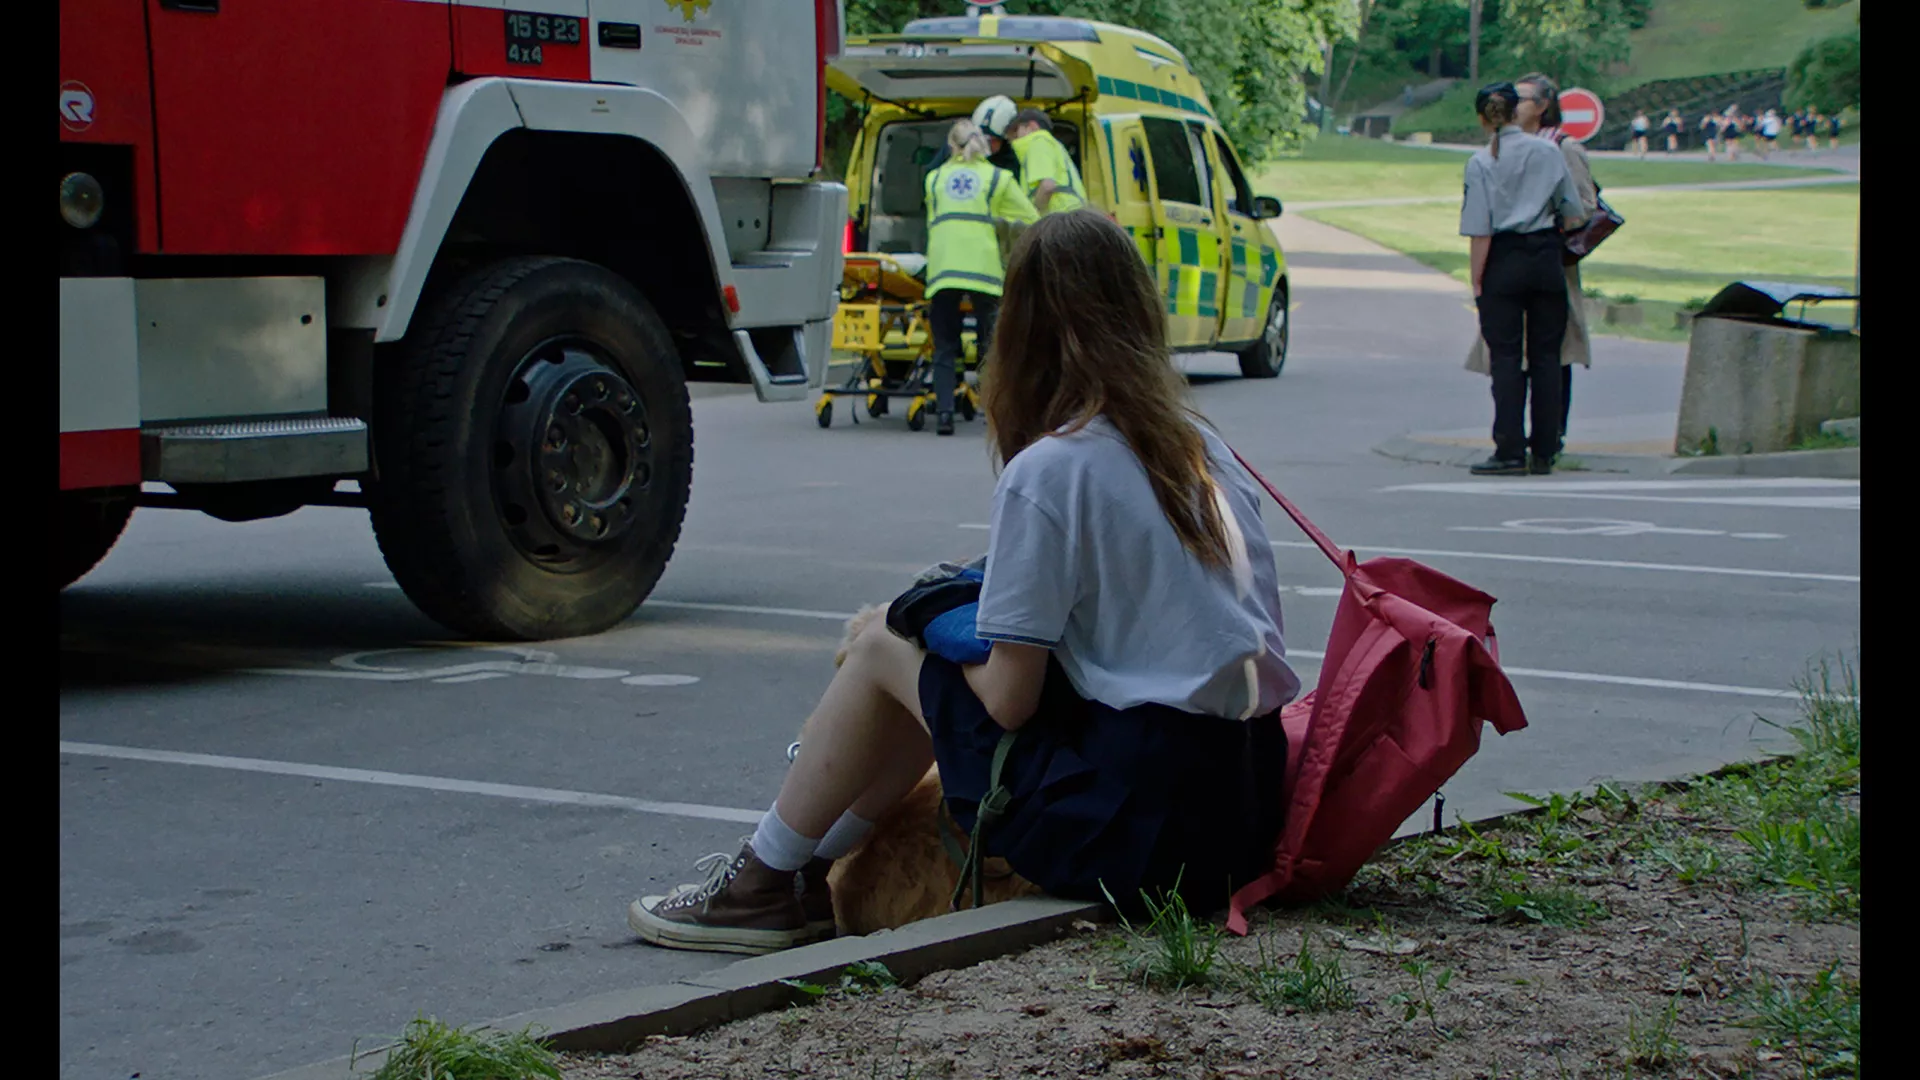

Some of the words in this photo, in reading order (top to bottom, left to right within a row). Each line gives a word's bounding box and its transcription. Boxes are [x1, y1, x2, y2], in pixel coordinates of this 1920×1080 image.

[508, 13, 532, 38] 15
[535, 16, 550, 40] S
[554, 18, 580, 42] 23
[508, 43, 543, 64] 4x4
